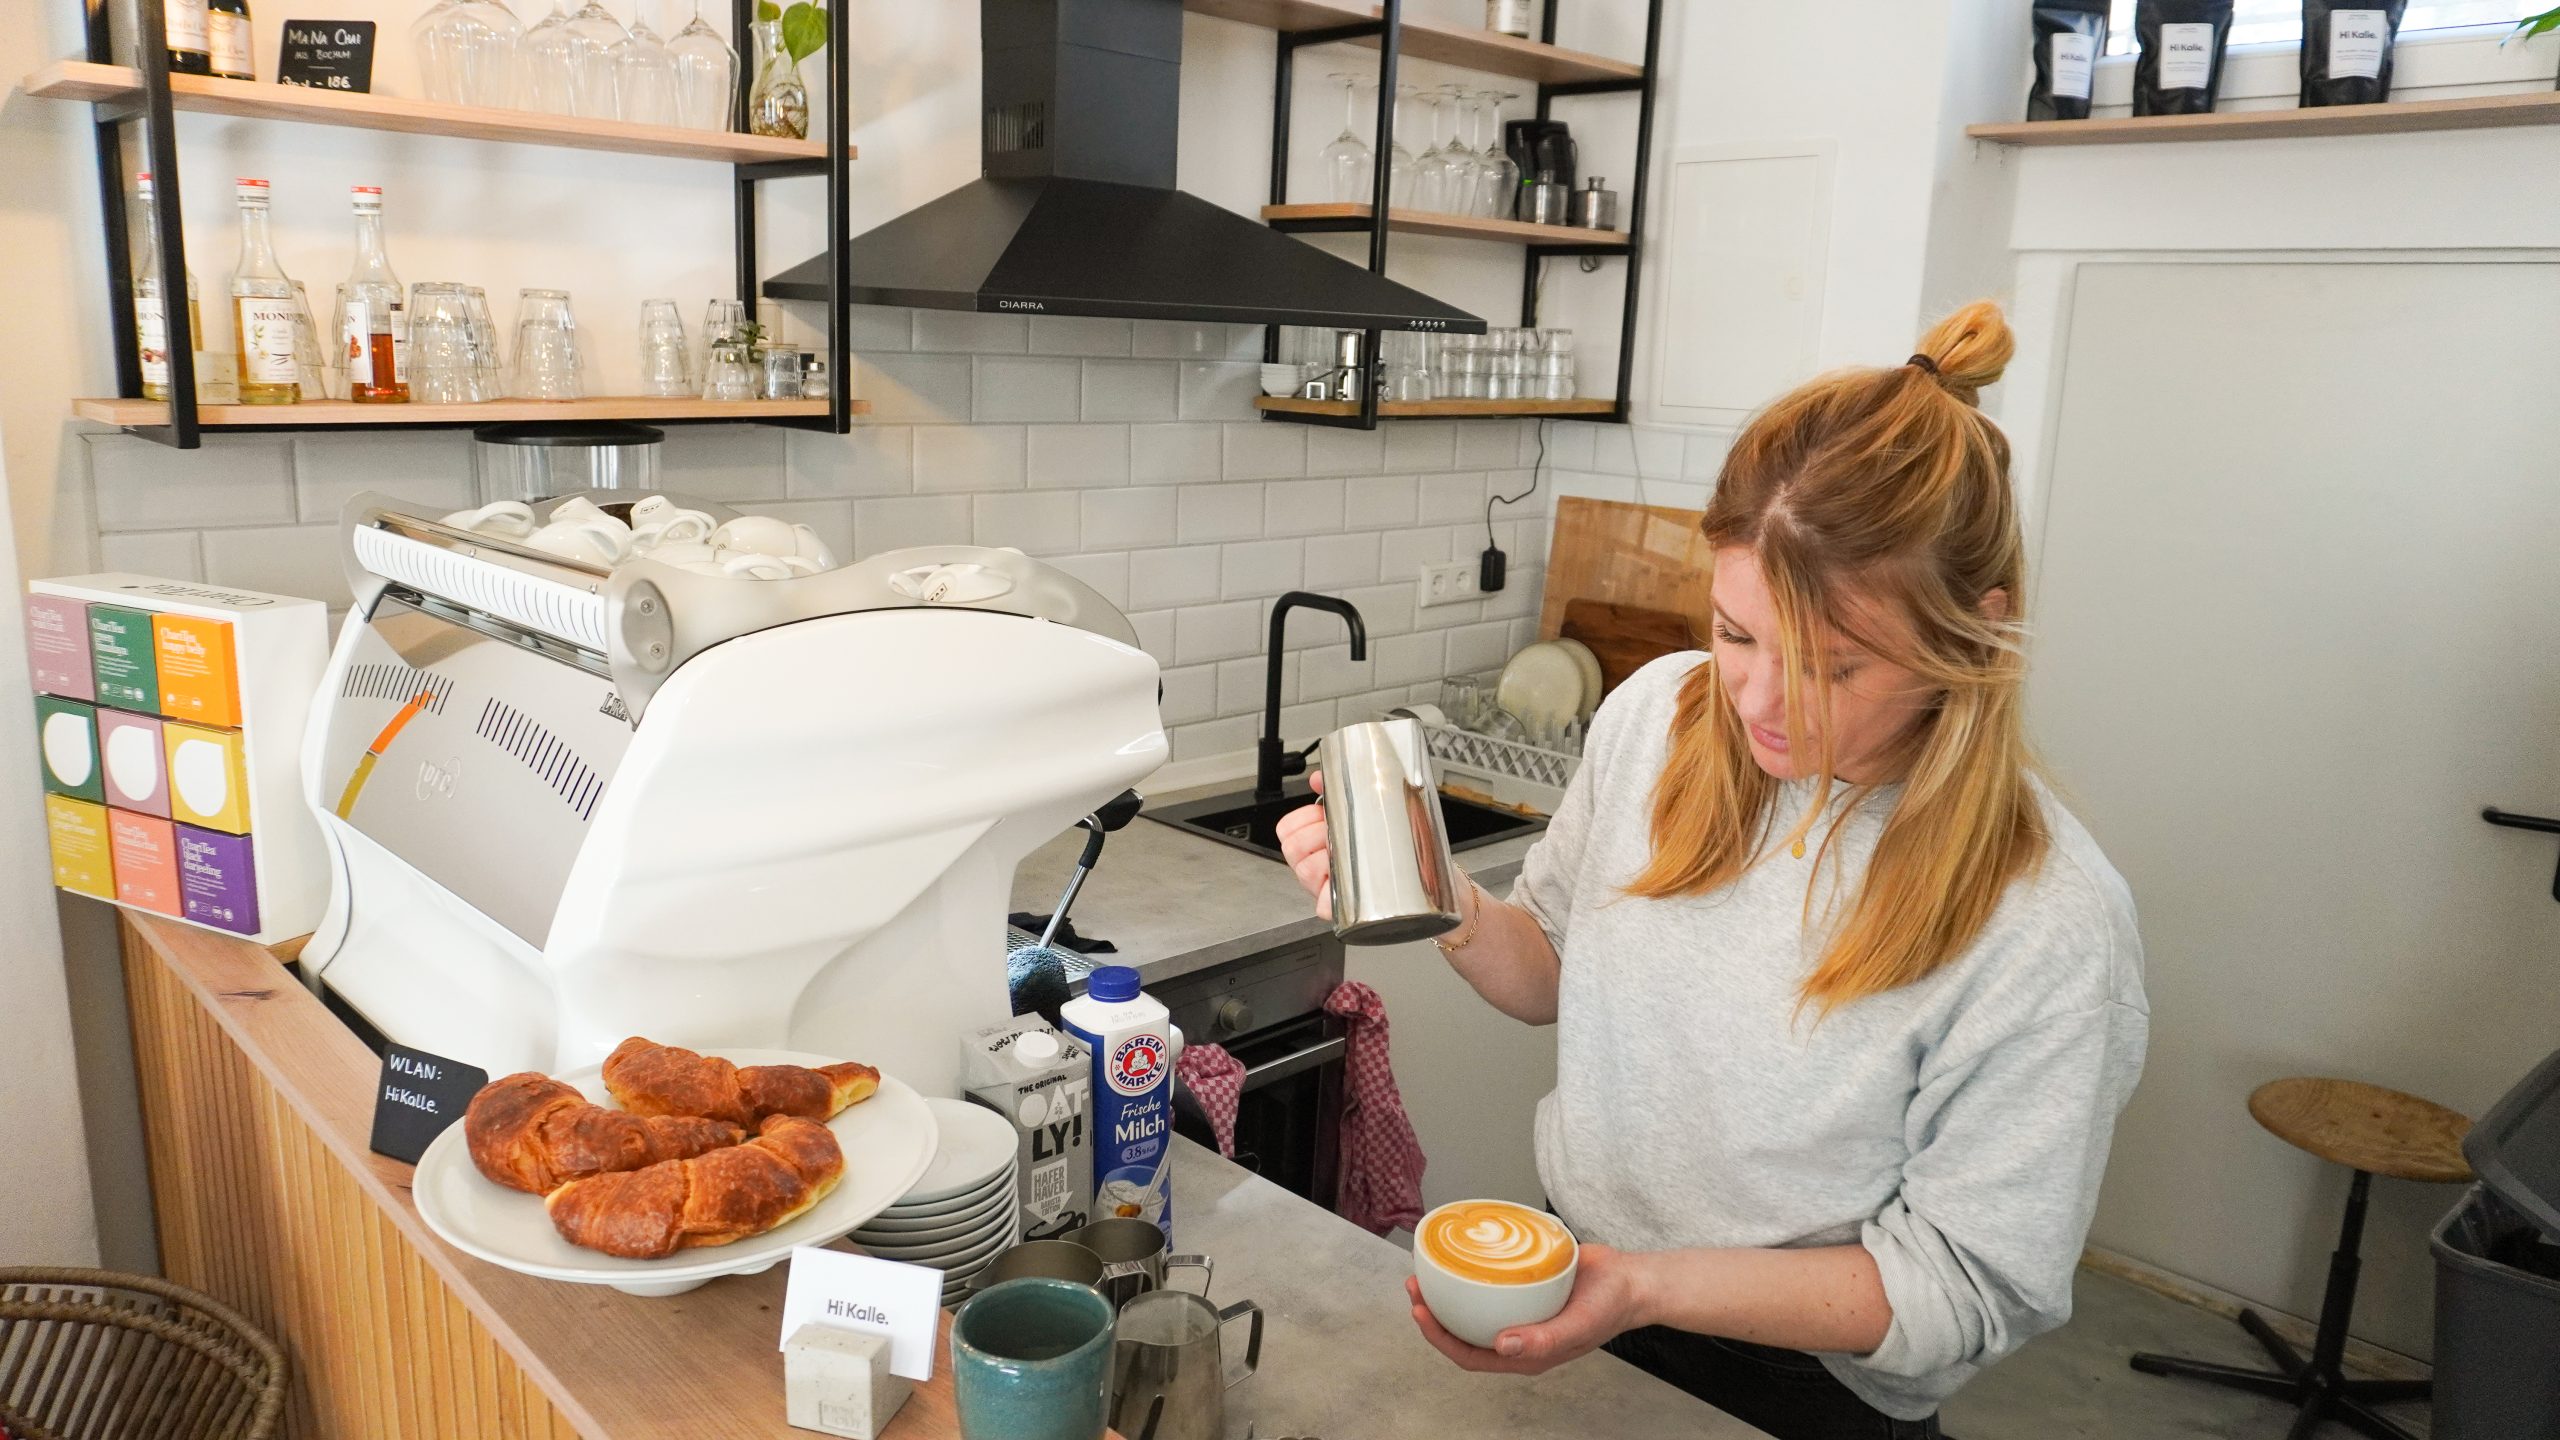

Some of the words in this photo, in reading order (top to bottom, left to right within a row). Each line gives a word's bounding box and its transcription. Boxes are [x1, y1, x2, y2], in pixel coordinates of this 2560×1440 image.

[1115, 1037, 1163, 1062] BÄREN
[390, 1053, 442, 1080] WLAN:
[1116, 1061, 1163, 1087] MARKE
[1018, 1083, 1034, 1095] THE
[1034, 1074, 1067, 1090] ORIGINAL
[1121, 1095, 1161, 1121] Frische
[1032, 1114, 1081, 1162] LY!
[1115, 1113, 1164, 1145] Milch
[1034, 1165, 1064, 1187] HAFER
[1034, 1179, 1064, 1203] HAVER
[827, 1298, 843, 1316] Hi
[846, 1302, 889, 1325] Kalle.
